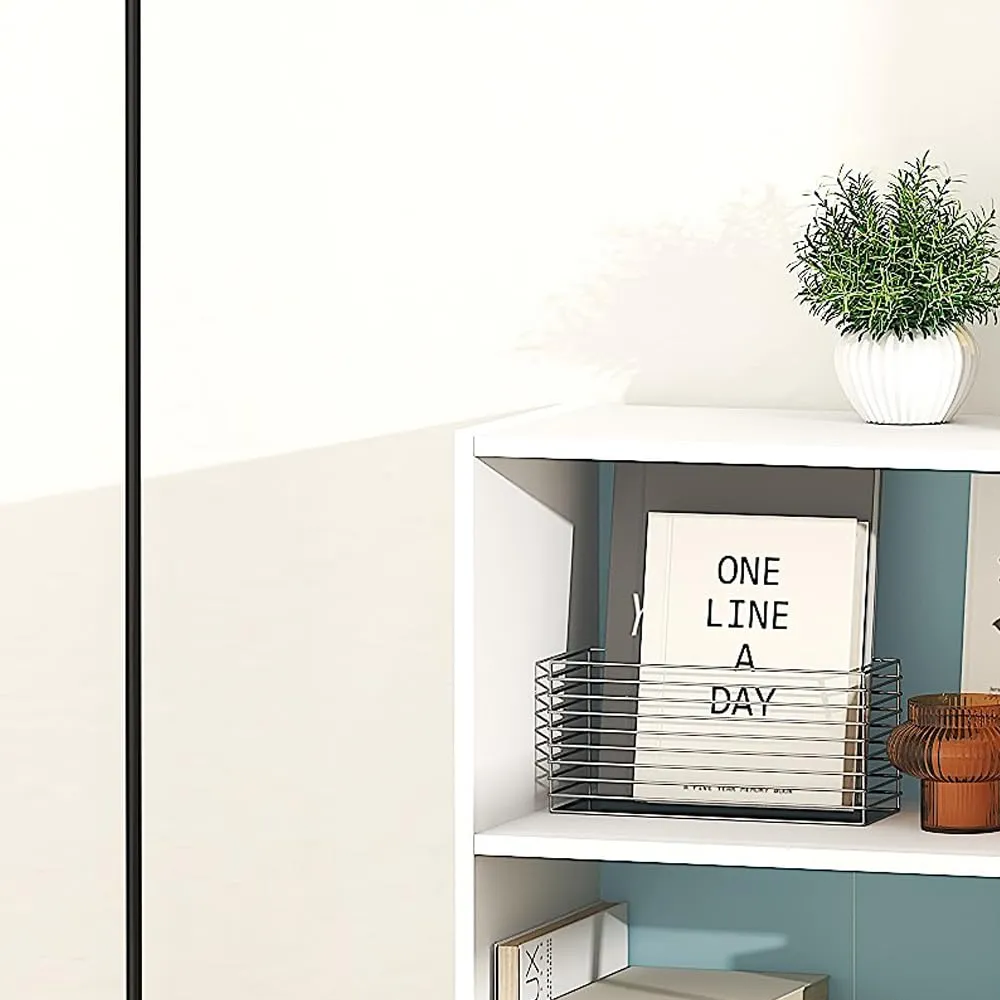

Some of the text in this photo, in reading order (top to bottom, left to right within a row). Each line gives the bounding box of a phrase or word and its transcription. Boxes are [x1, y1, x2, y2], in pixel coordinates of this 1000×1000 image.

[718, 555, 781, 586] ONE
[707, 598, 789, 630] LINE
[735, 643, 756, 672] A
[710, 686, 777, 717] DAY
